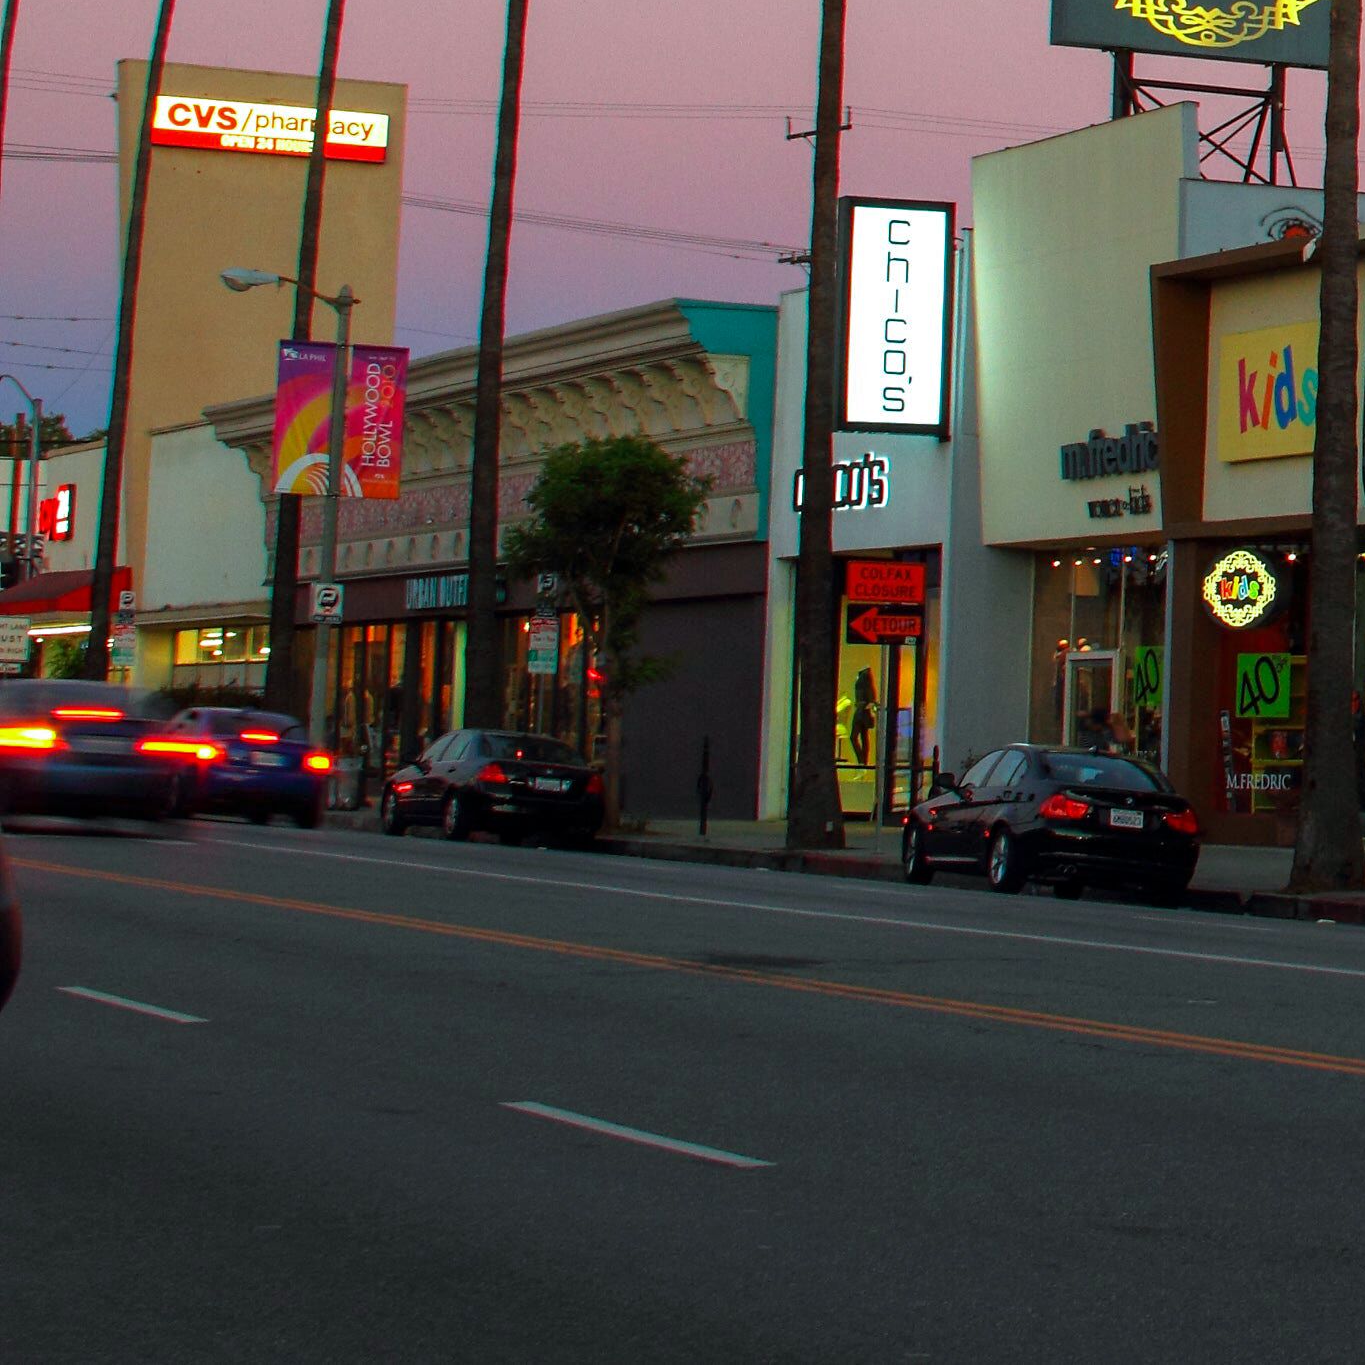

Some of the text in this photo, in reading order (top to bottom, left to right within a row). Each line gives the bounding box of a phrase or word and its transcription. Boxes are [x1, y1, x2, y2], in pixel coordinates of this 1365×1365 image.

[1237, 343, 1319, 435] kids
[360, 362, 381, 467] HOLLYWOOD
[376, 420, 393, 468] BOWL
[854, 584, 916, 598] CLOSURE
[860, 567, 912, 581] COLFAX
[1219, 574, 1260, 601] kids
[862, 617, 916, 632] DETOUR
[1134, 648, 1161, 704] 40
[1239, 655, 1281, 717] 40
[1225, 773, 1292, 791] M.FREDRIC
